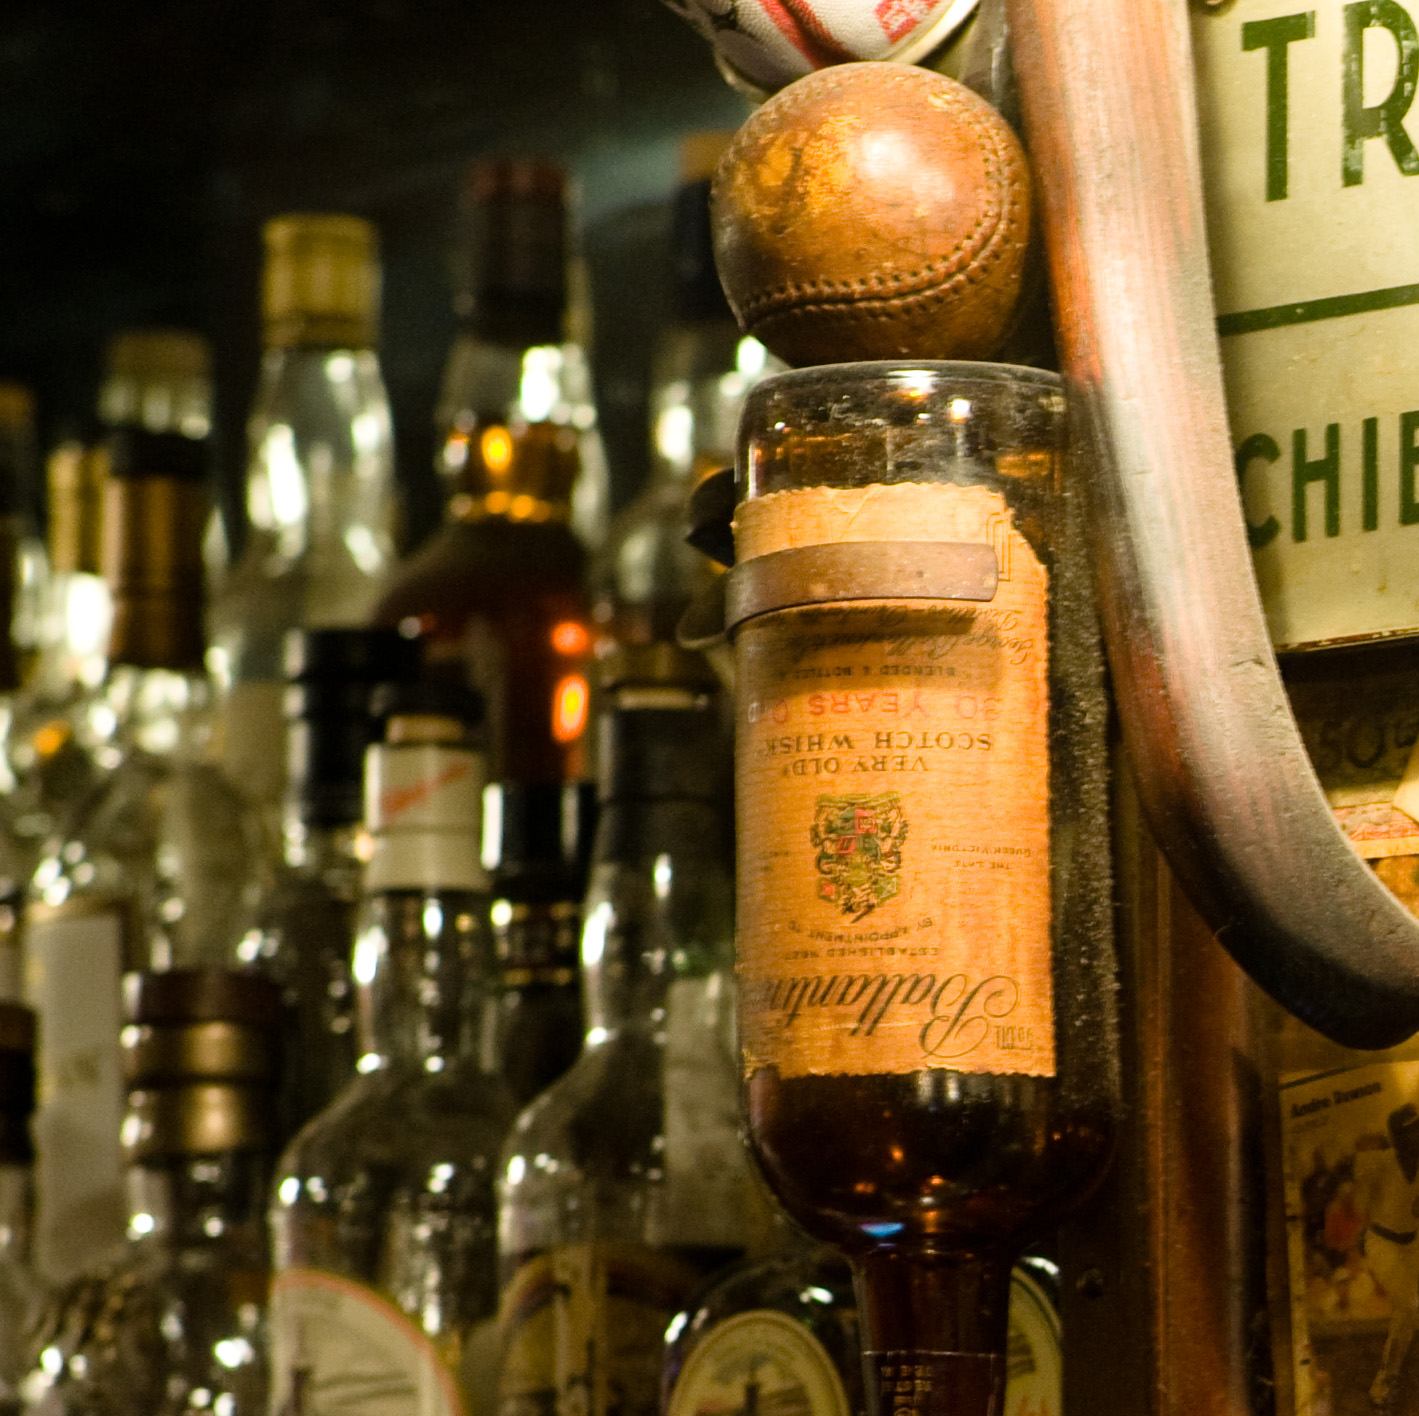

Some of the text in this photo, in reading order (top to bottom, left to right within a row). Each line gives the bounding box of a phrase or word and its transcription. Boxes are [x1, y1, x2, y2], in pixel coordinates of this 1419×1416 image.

[806, 692, 929, 721] YEARS
[873, 731, 992, 751] SCOTCH
[850, 755, 929, 774] VERY
